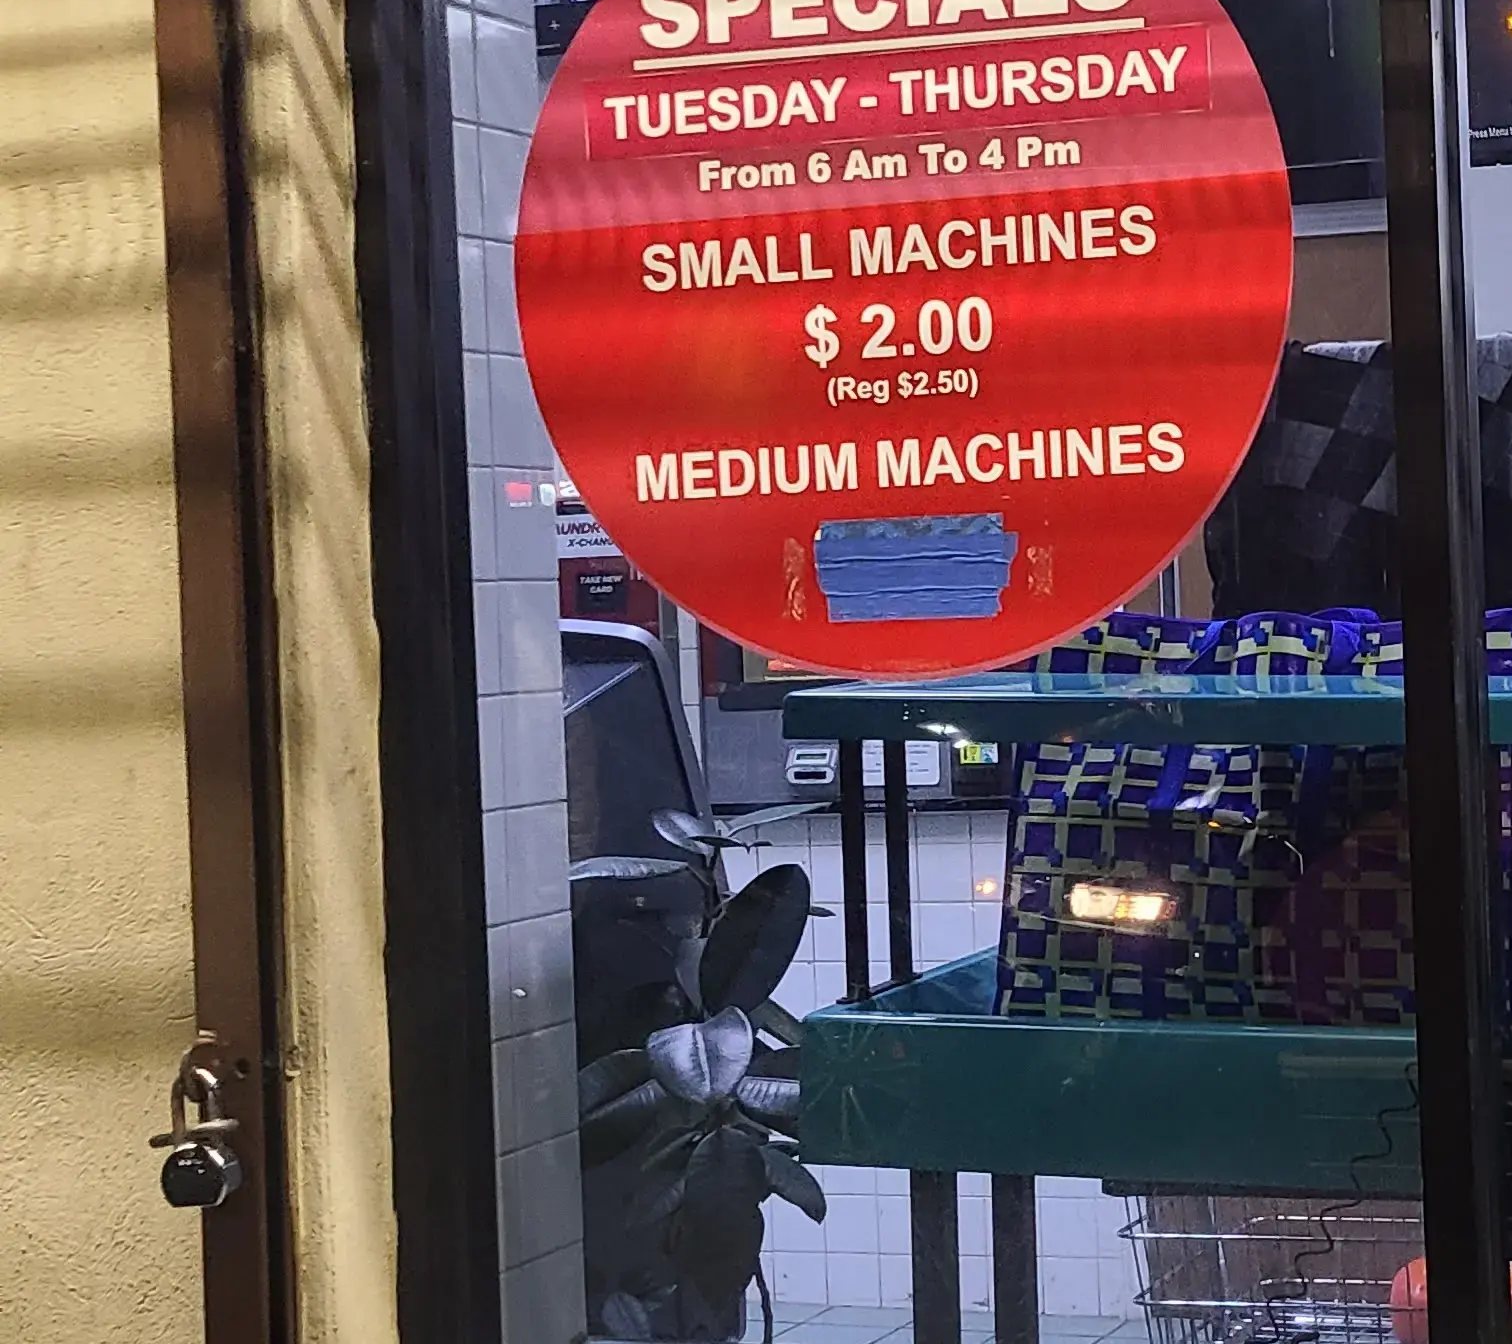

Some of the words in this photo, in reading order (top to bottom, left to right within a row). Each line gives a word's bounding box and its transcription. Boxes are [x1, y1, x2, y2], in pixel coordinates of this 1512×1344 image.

[604, 78, 846, 139] TUESDAY
[891, 45, 1187, 115] THURSDAY
[700, 161, 795, 191] From
[809, 153, 831, 182] 6
[843, 150, 906, 180] Am
[919, 144, 967, 174] To
[980, 139, 1004, 169] 4
[1018, 137, 1080, 167] Pm
[643, 234, 832, 291] SMALL
[850, 206, 1155, 275] MACHINES
[805, 304, 840, 369] $
[861, 297, 992, 358] 2.00
[828, 377, 889, 406] (Reg
[898, 369, 977, 398] $2.50)
[637, 443, 857, 501] MEDIUM
[877, 423, 1184, 487] MACHINES
